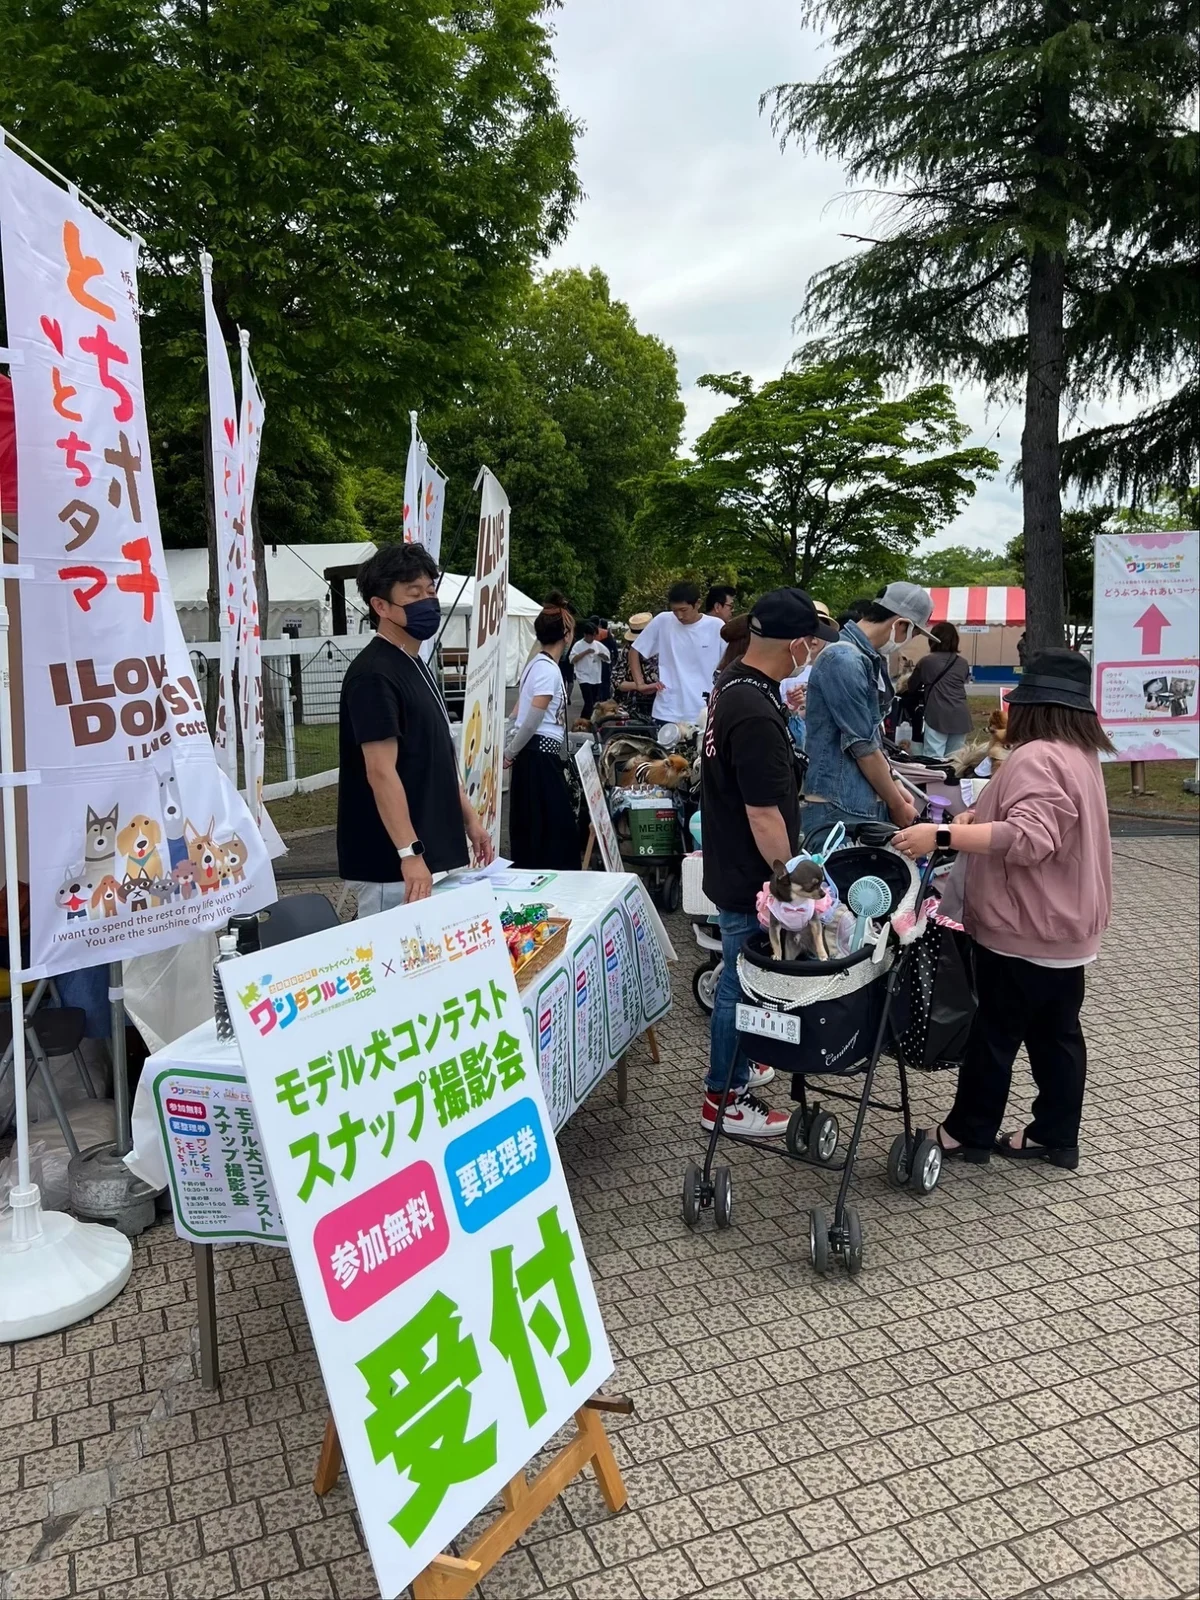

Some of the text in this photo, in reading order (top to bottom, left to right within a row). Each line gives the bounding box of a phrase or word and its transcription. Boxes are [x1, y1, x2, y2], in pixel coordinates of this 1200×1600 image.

[52, 366, 107, 612] とちタマ
[1104, 586, 1200, 598] どうぶつふれあいコーナ
[49, 662, 73, 706] I
[75, 654, 168, 702] Lov
[175, 720, 207, 737] cats
[52, 934, 57, 944] I
[58, 930, 85, 942] want
[88, 925, 99, 936] to
[102, 919, 134, 934] spend
[136, 913, 153, 925] the
[155, 909, 173, 921] rest
[175, 904, 186, 916] of
[188, 902, 201, 915] my
[202, 899, 214, 911] life
[215, 891, 236, 906] with
[85, 903, 236, 948] You are the sunshine of my life.
[443, 918, 493, 953] とちポチ
[249, 963, 374, 1036] ワンダフルとちぎ
[354, 985, 377, 1001] 2024
[275, 979, 508, 1116] モデル犬コンテスト
[168, 1102, 203, 1116] 参加無料
[289, 1031, 526, 1203] スナップ撮影会
[185, 1141, 200, 1174] モデルに
[196, 1138, 213, 1178] ワンとちの
[212, 1104, 250, 1206] スナップ撮影会
[234, 1106, 274, 1232] モデル犬コンテスト
[456, 1125, 539, 1207] 要整理券
[330, 1189, 435, 1290] 参加無料
[354, 1204, 593, 1549] 受付
